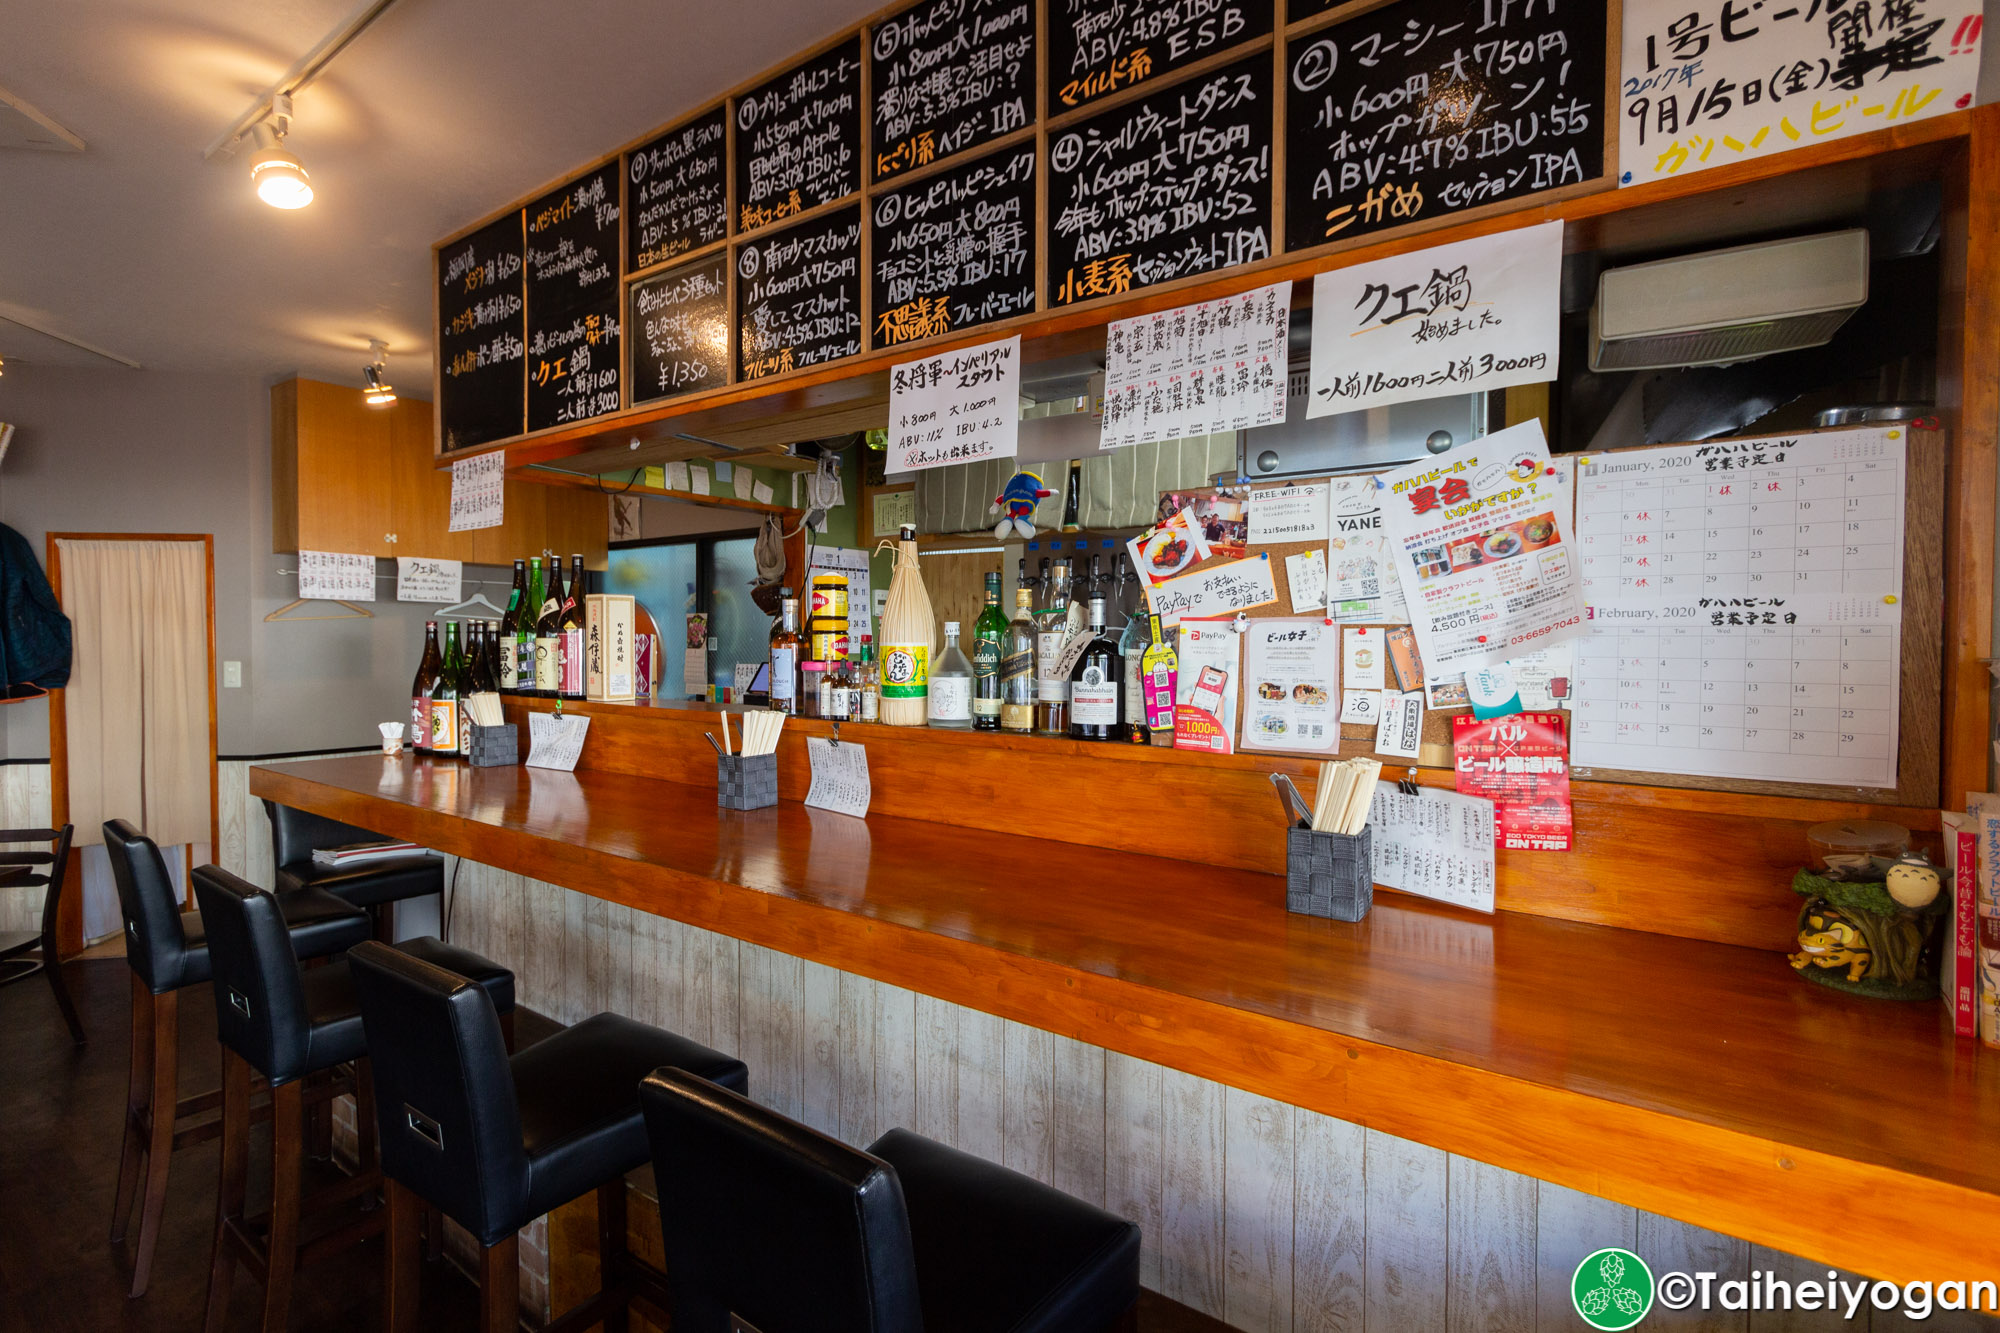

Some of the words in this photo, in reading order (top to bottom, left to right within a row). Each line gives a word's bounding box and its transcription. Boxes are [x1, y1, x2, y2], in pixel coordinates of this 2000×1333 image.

[1350, 20, 1464, 67] マーシー
[1059, 47, 1152, 106] マイルド系
[1625, 60, 1704, 97] 2017年
[991, 96, 1026, 134] IPA
[1654, 84, 1943, 173] ガハハビール
[1057, 253, 1133, 304] 小麦系
[1354, 265, 1472, 326] クエ鍋
[537, 345, 591, 387] クエ鍋
[1660, 457, 1691, 468] 2020
[1408, 478, 1471, 515] 宴会
[1337, 517, 1381, 531] YANE
[1664, 607, 1695, 617] 2020
[1201, 631, 1227, 640] PayPay
[1267, 630, 1307, 642] ビール女子
[1489, 725, 1527, 741] バル
